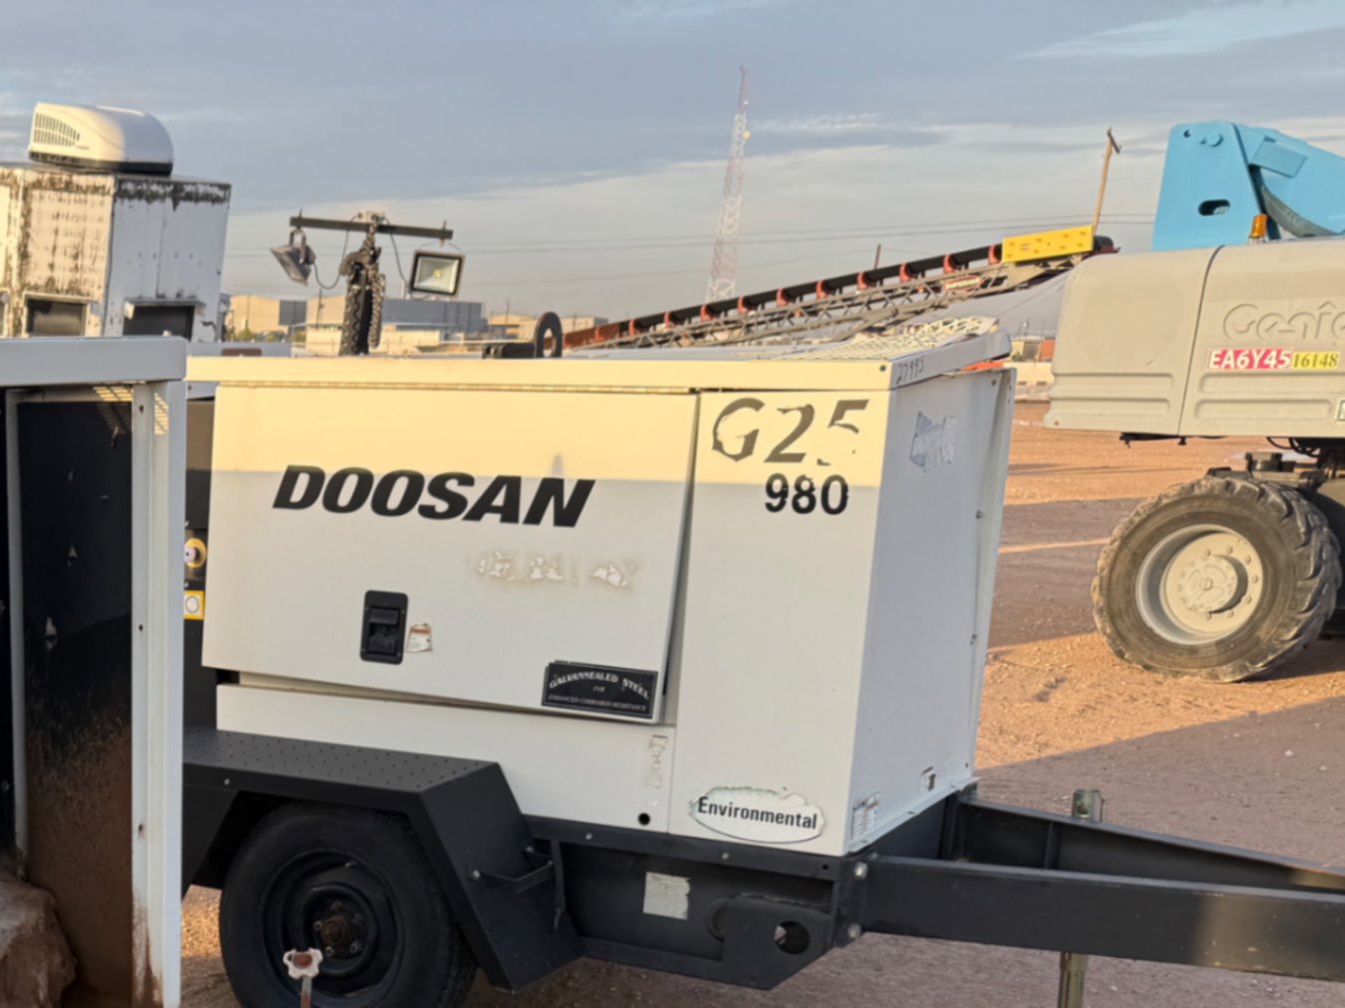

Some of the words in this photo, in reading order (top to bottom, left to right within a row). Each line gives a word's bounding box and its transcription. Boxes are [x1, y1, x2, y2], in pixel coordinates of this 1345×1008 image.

[1209, 349, 1291, 369] EA6Y45
[1293, 352, 1339, 369] 16148
[272, 466, 596, 528] DOOSAN
[764, 473, 849, 516] 980
[622, 678, 649, 699] STEEL
[697, 795, 818, 830] Environmental
